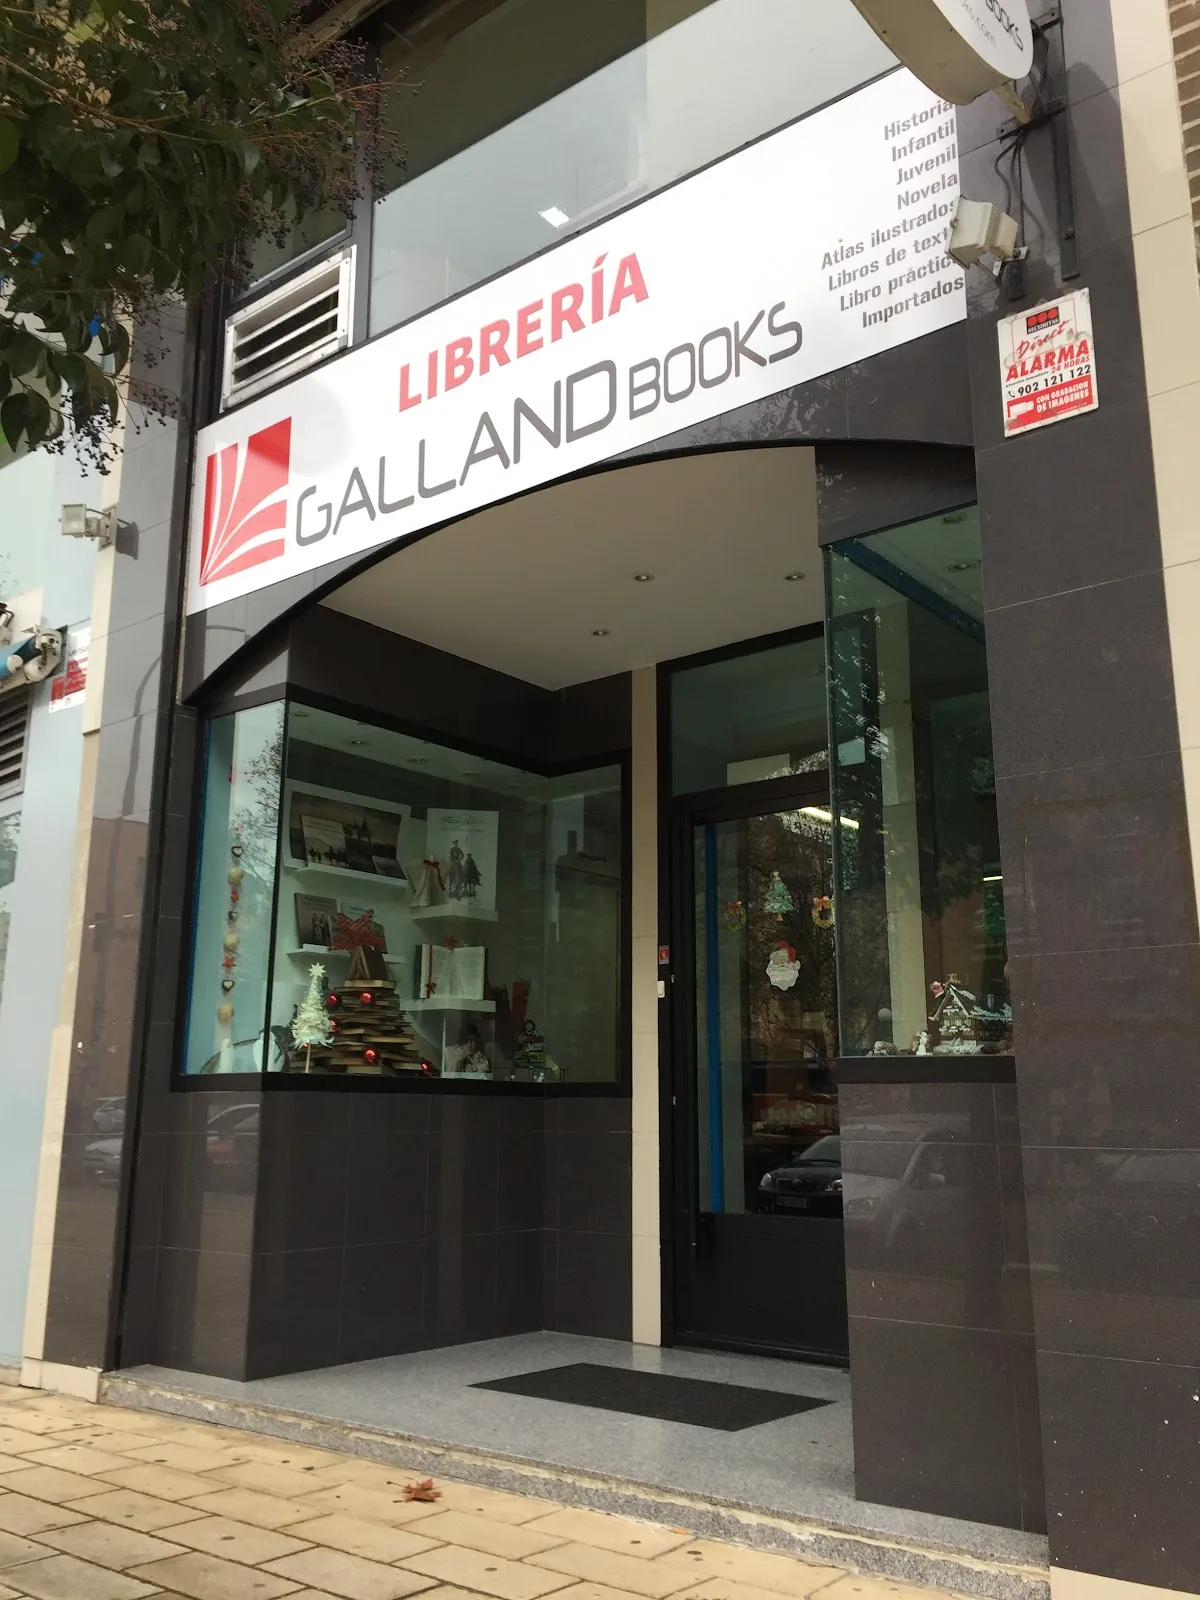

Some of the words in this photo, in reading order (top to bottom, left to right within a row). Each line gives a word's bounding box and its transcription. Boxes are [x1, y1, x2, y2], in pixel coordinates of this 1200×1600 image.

[884, 99, 954, 141] Historia
[891, 118, 955, 162] Infantil
[896, 143, 957, 186] Juvenil
[897, 173, 958, 210] Novela
[821, 240, 865, 270] Atlas
[828, 260, 880, 291] Libros
[885, 247, 907, 267] de
[912, 226, 948, 254] text
[840, 284, 882, 312] Libro
[888, 254, 954, 295] práctic
[862, 277, 964, 328] Importados
[398, 252, 650, 413] LIBRERÍA
[1016, 318, 1073, 359] Direct
[1005, 340, 1090, 382] ALARMA
[1018, 381, 1040, 396] 902
[1044, 373, 1064, 388] 121
[1070, 364, 1092, 379] 122
[1051, 366, 1061, 374] 24
[1064, 354, 1091, 370] HORAS
[1036, 393, 1050, 404] CON
[1051, 380, 1089, 399] GRABACION
[1036, 401, 1047, 414] DE
[1048, 389, 1090, 408] IMAGENES
